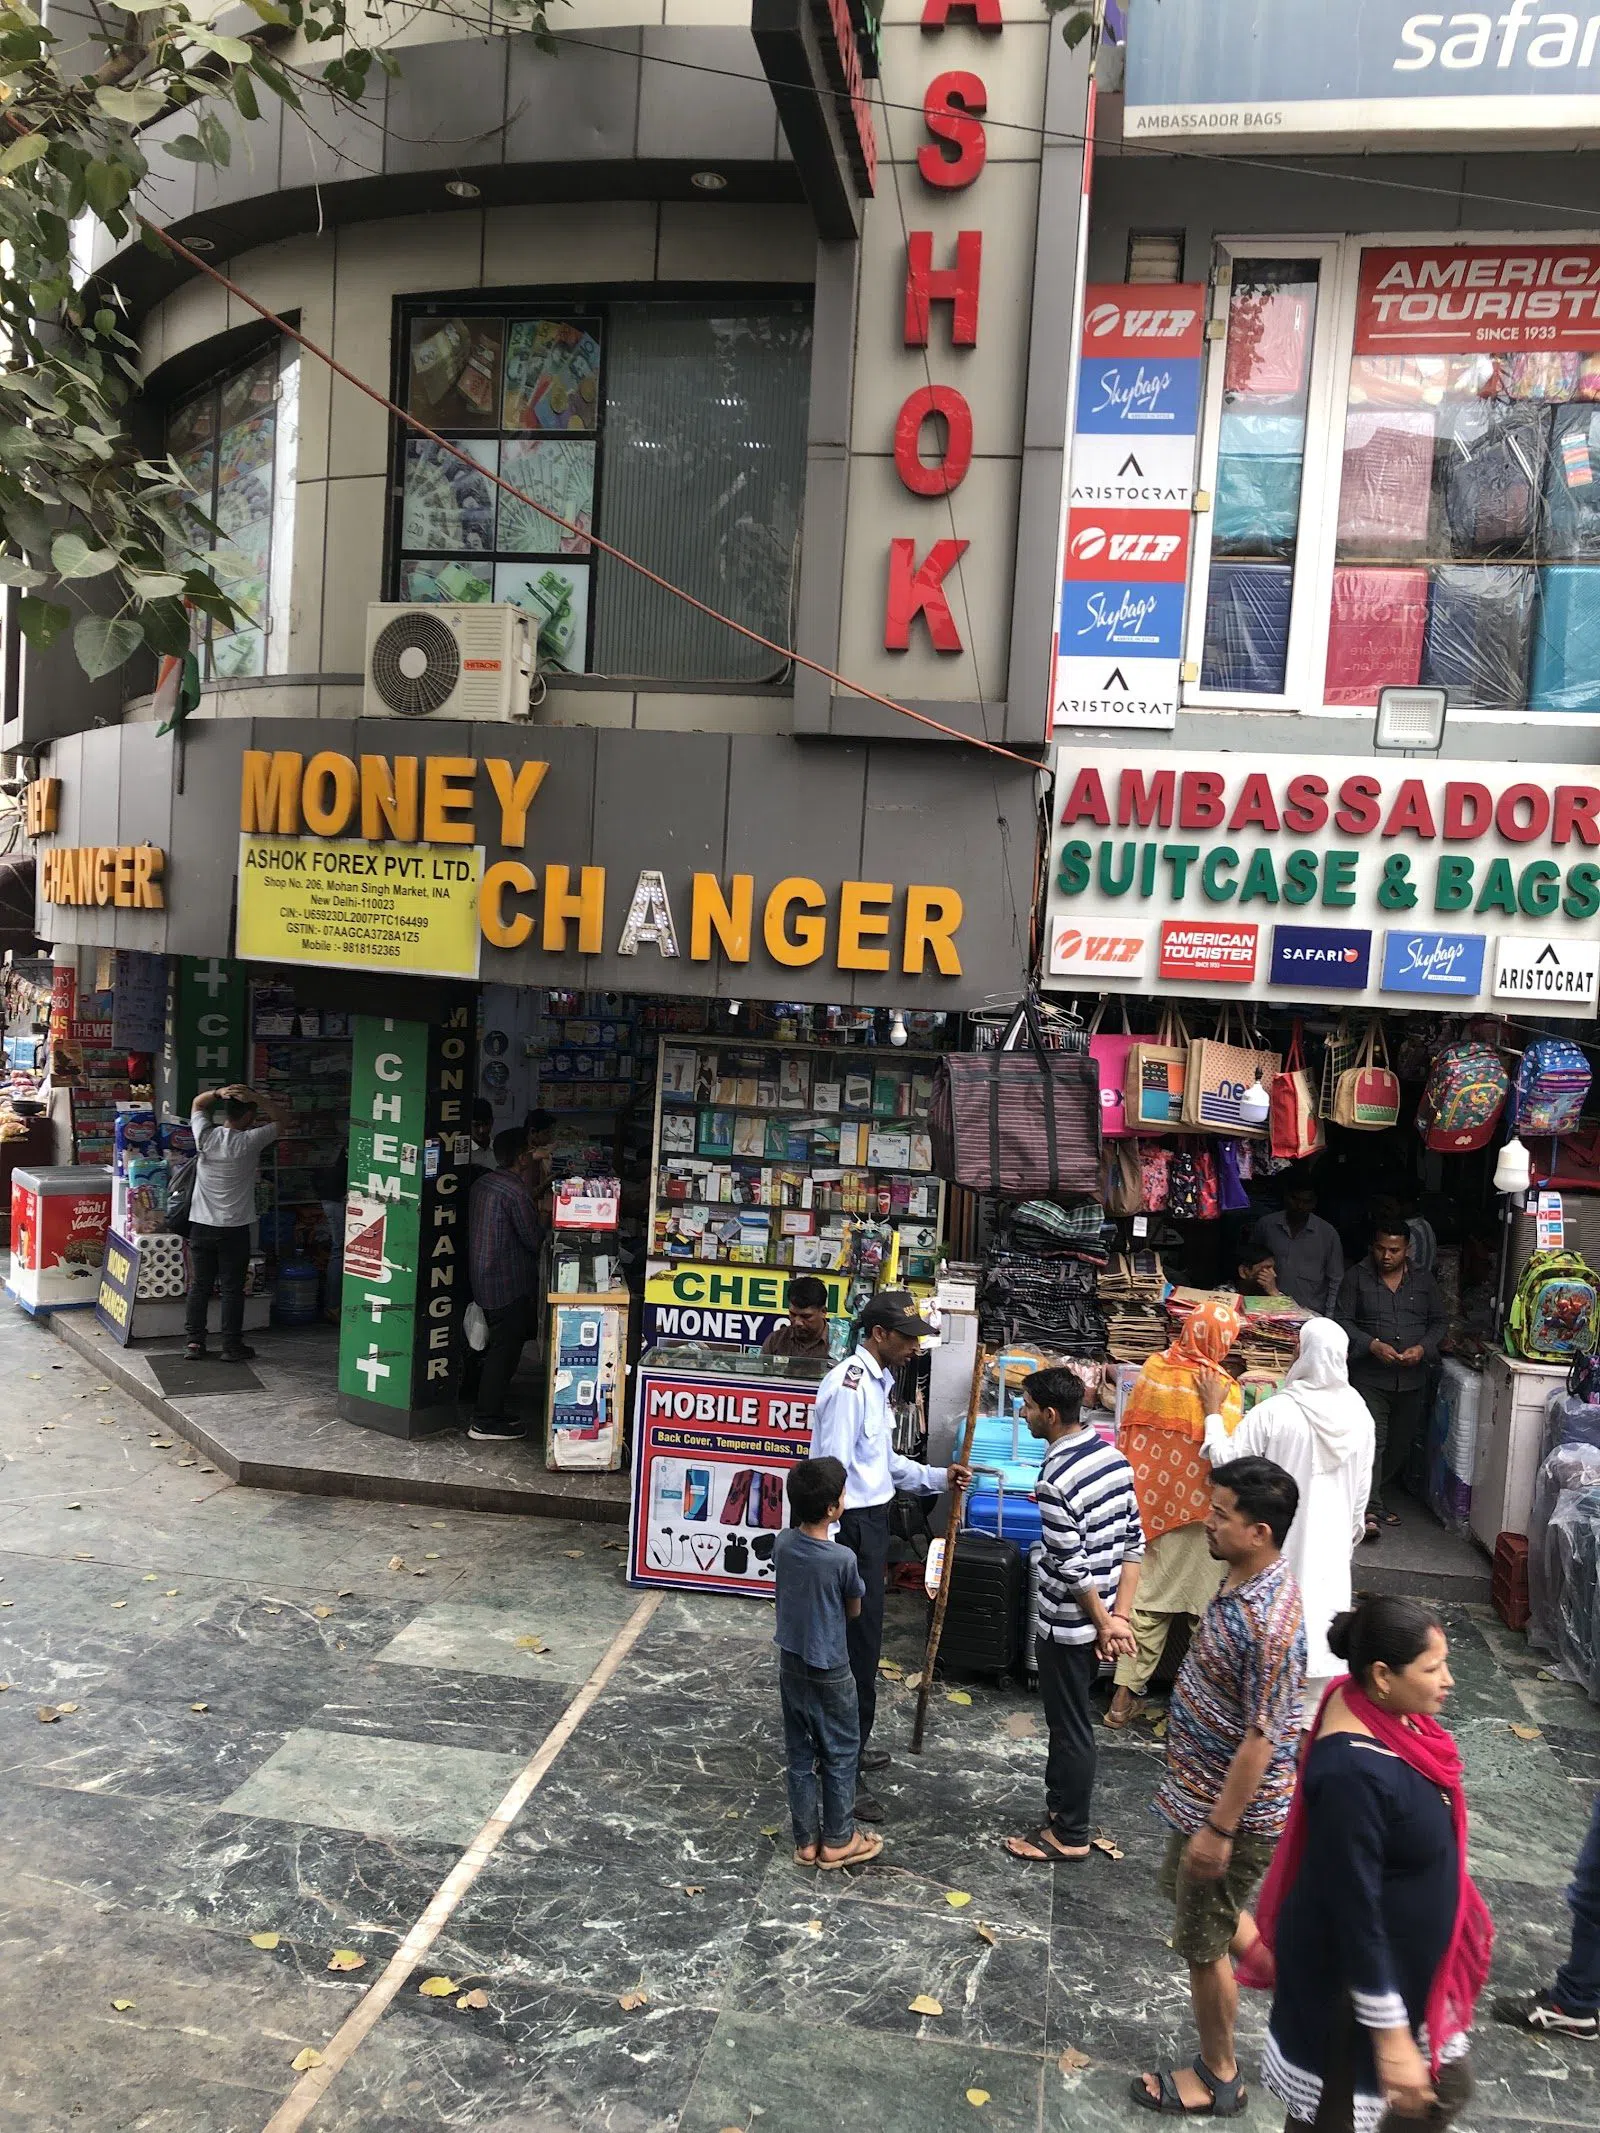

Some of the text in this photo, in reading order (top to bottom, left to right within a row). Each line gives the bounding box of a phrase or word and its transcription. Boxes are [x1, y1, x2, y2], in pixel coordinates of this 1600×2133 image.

[1137, 112, 1283, 129] AMBASSADOR BAGS
[1476, 326, 1556, 341] SINCE 1933
[1092, 367, 1171, 419] Skybags
[1072, 487, 1188, 500] ARISTOCRAT
[1077, 590, 1157, 641] Skybags
[1057, 700, 1173, 715] ARISTOCRAT
[240, 750, 550, 848] MONEY
[1060, 767, 1600, 844] AMBASSADOR
[42, 846, 164, 909] CHANGER
[245, 848, 475, 882] ASHOK FOREX PVT. LTD.
[1057, 840, 1600, 919] SUITCASE & BAGS
[264, 876, 286, 889] Shop
[288, 878, 303, 889] No.
[327, 880, 358, 893] Mohan
[361, 882, 390, 896] Singh
[393, 885, 429, 899] Market,
[432, 887, 450, 898] INA
[310, 894, 395, 911] New Delhi-110023
[480, 861, 963, 976] CHANGER
[301, 938, 331, 951] Mobile
[343, 943, 401, 957] 9818152365
[1164, 945, 1253, 961] TOURISTER
[1165, 932, 1255, 947] AMERICAN
[1282, 947, 1343, 963] SAFARI
[1399, 938, 1465, 979] Skybags
[1499, 968, 1594, 993] ARISTOCRAT
[107, 1247, 131, 1285] MONEY
[99, 1281, 128, 1328] CHANGER
[656, 1307, 764, 1341] MONEY
[650, 1389, 758, 1425] MOBILE
[658, 1431, 681, 1444] Back
[684, 1434, 712, 1447] Cover,
[716, 1437, 761, 1451] Tempered
[764, 1441, 793, 1455] Glass,
